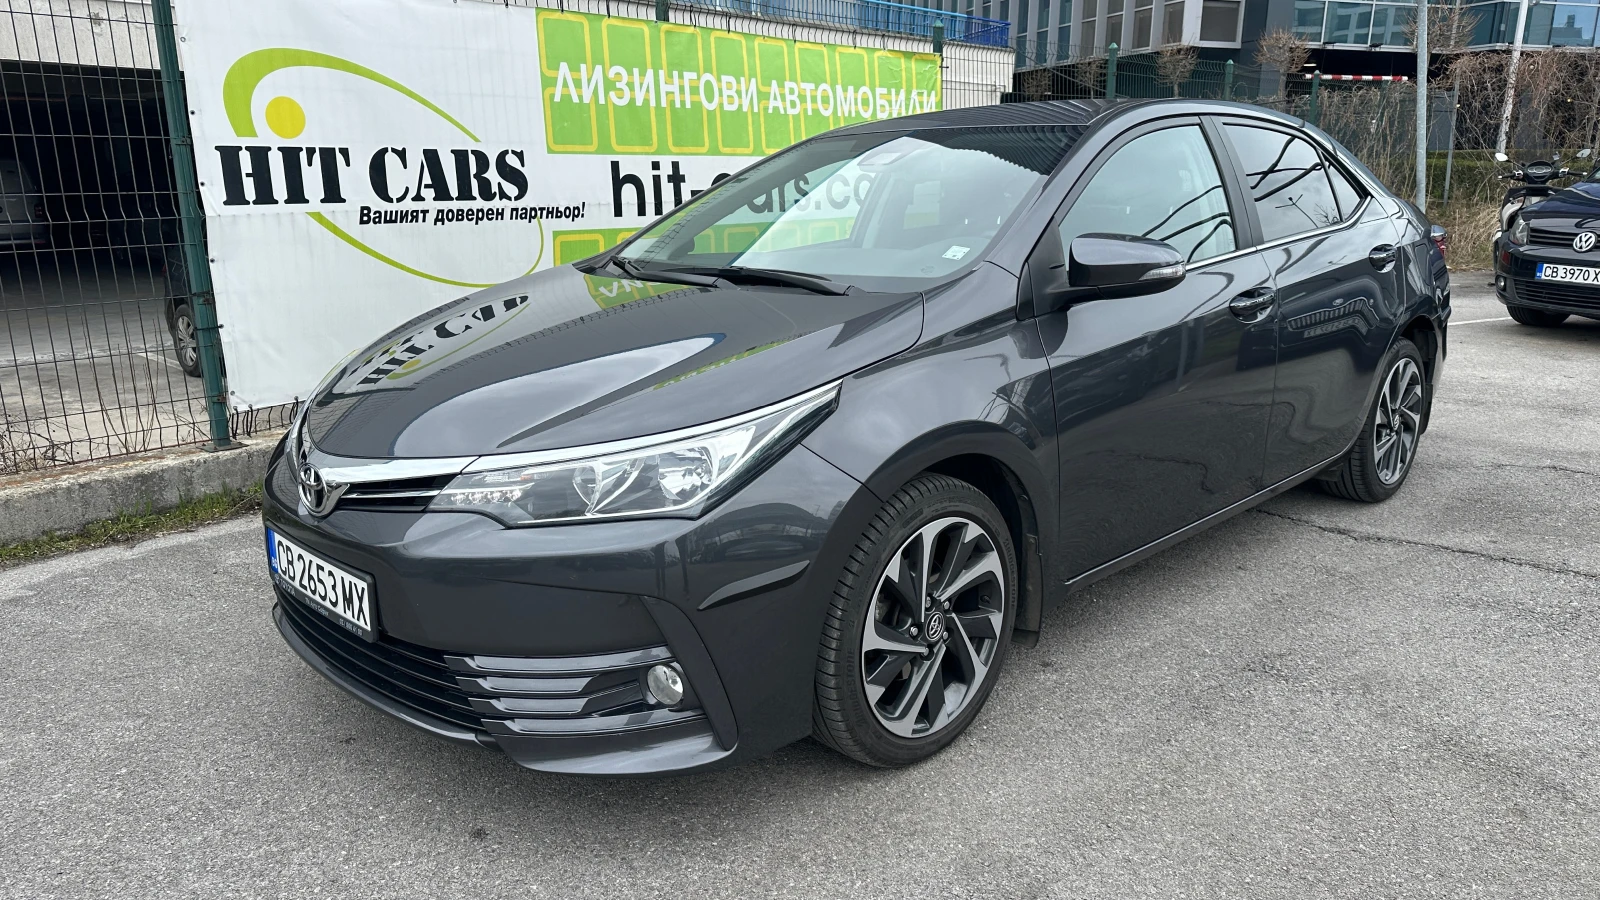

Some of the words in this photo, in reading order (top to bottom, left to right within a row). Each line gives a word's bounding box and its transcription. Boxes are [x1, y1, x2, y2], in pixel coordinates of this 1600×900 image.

[554, 61, 758, 113] ЛИЗИНГОВИ
[768, 80, 936, 120] АВТОМОБИЛИ
[214, 145, 350, 206] HIT
[369, 146, 529, 204] CARS
[359, 205, 429, 225] Вашият
[434, 206, 505, 225] доверен
[510, 202, 586, 223] партньор!
[1544, 266, 1559, 278] CB
[1560, 267, 1590, 281] 3970
[277, 540, 296, 583] CB
[297, 553, 338, 608] 2653
[341, 576, 368, 627] MX
